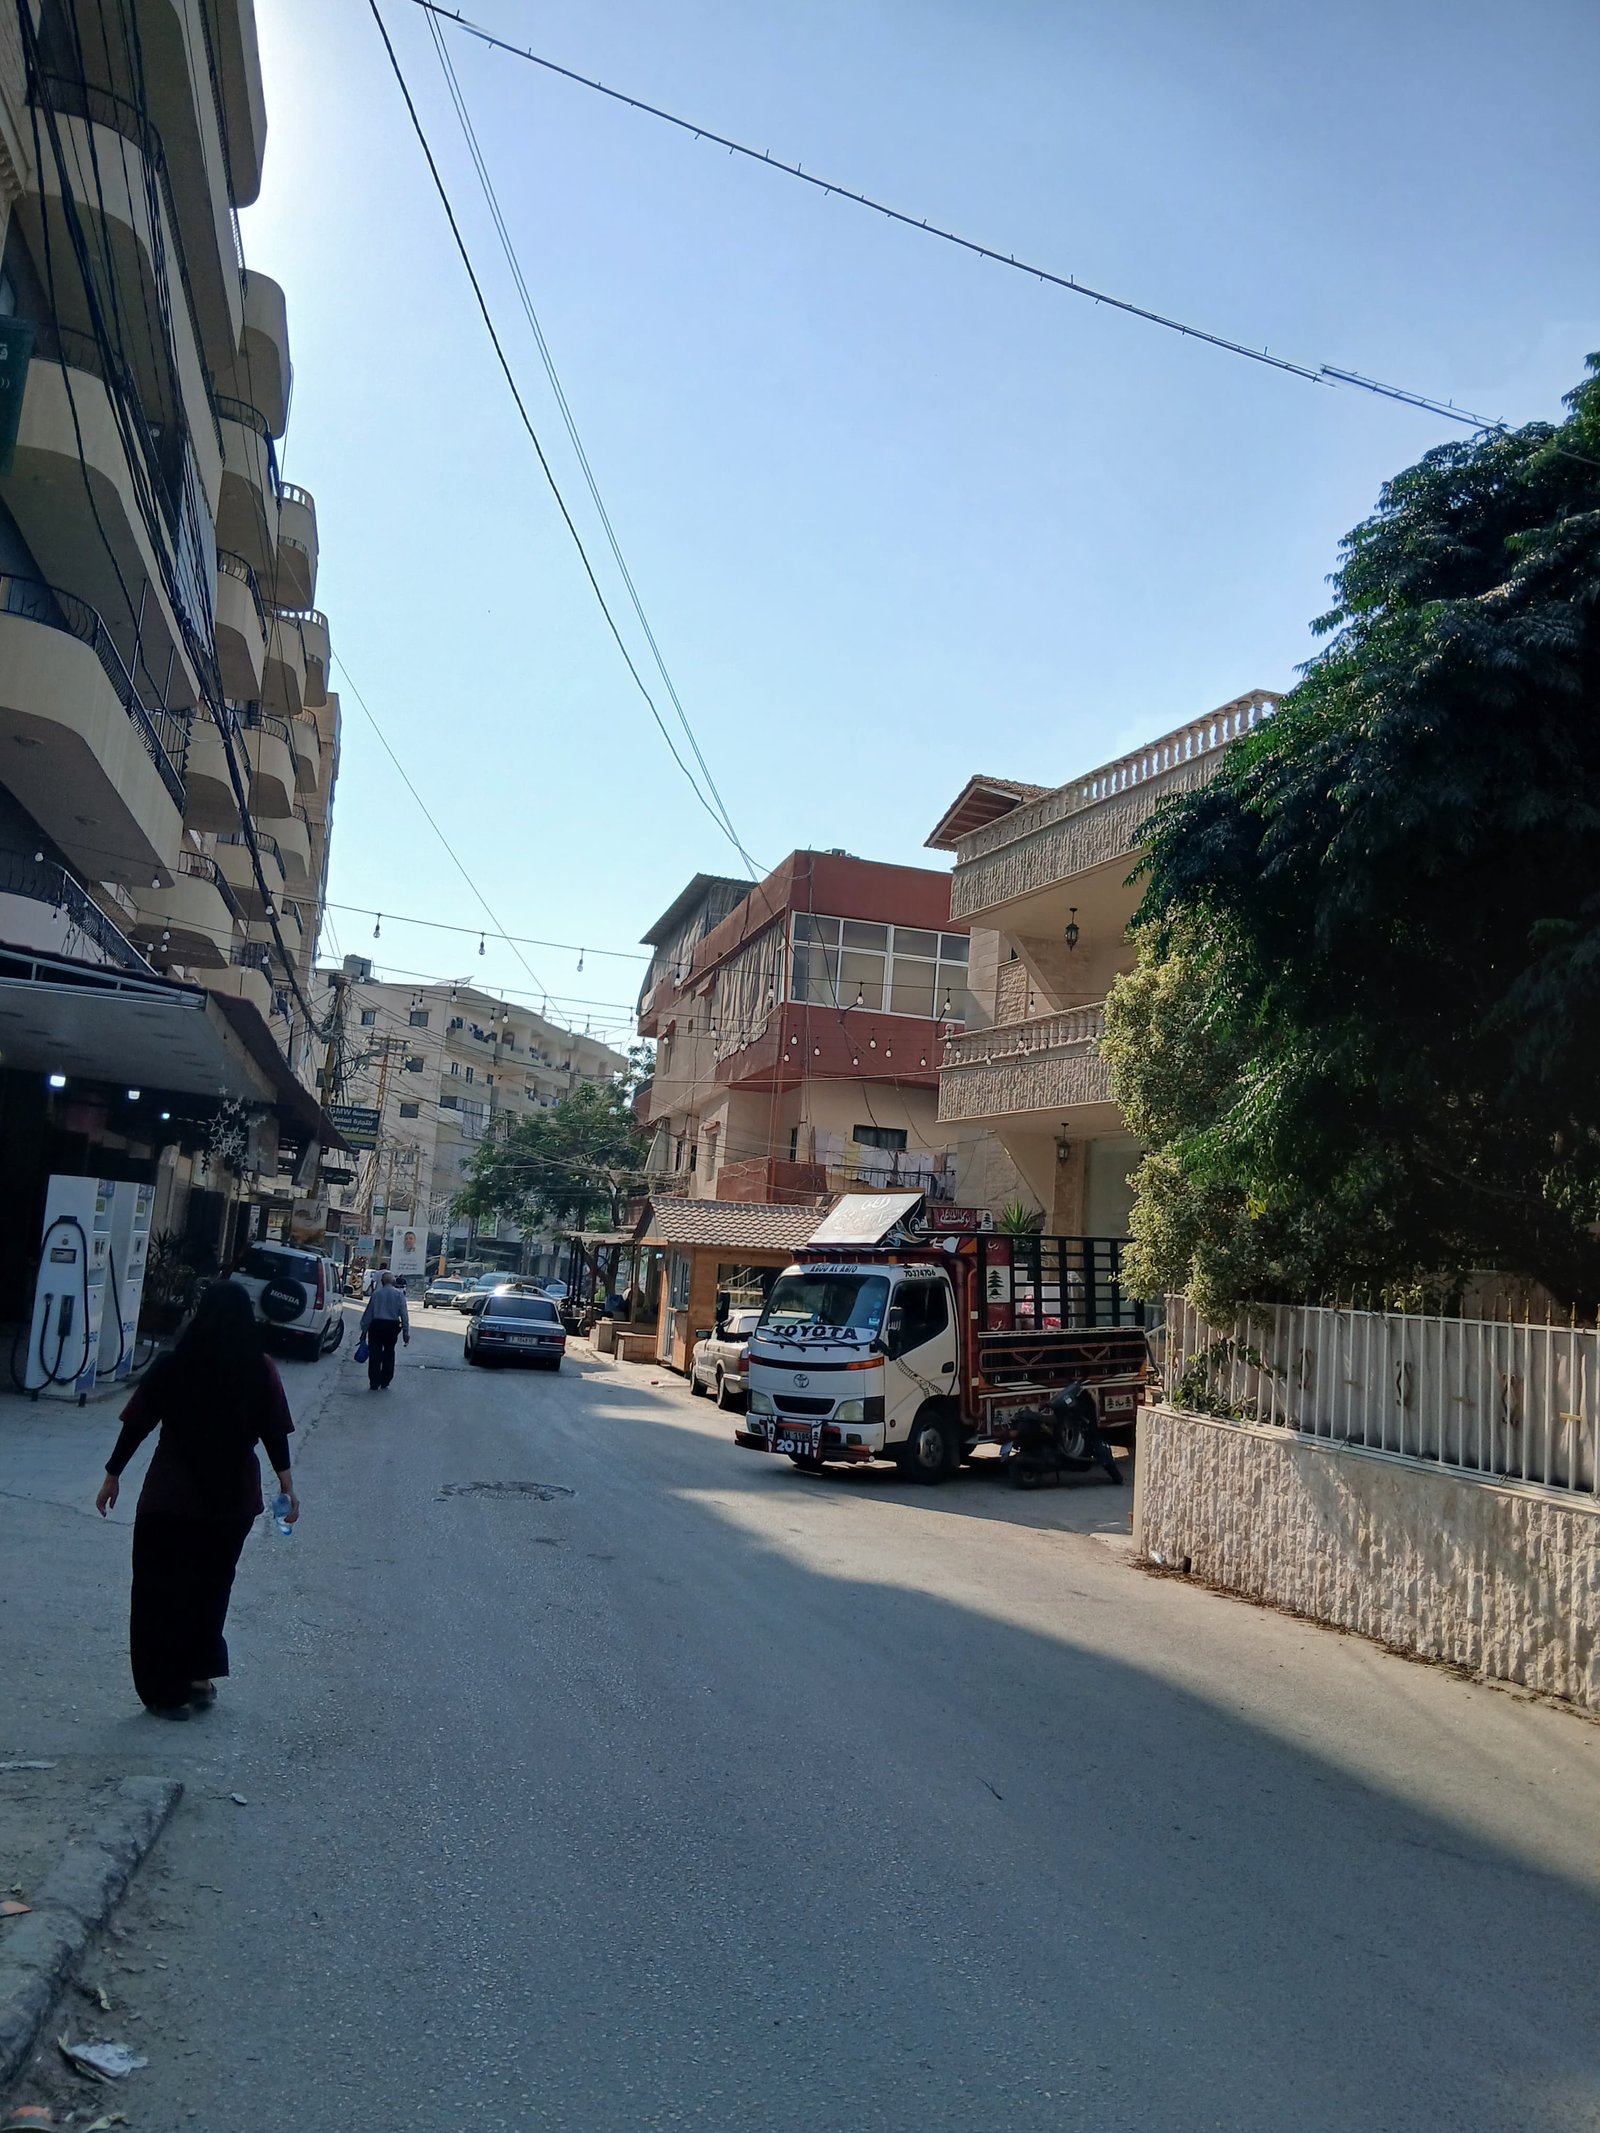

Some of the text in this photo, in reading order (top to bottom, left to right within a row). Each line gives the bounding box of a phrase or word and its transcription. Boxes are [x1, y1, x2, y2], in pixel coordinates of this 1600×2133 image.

[330, 1106, 352, 1115] GMW
[270, 1290, 299, 1305] HONDA
[773, 1325, 858, 1340] TOYOTA
[776, 1439, 810, 1455] 2011
